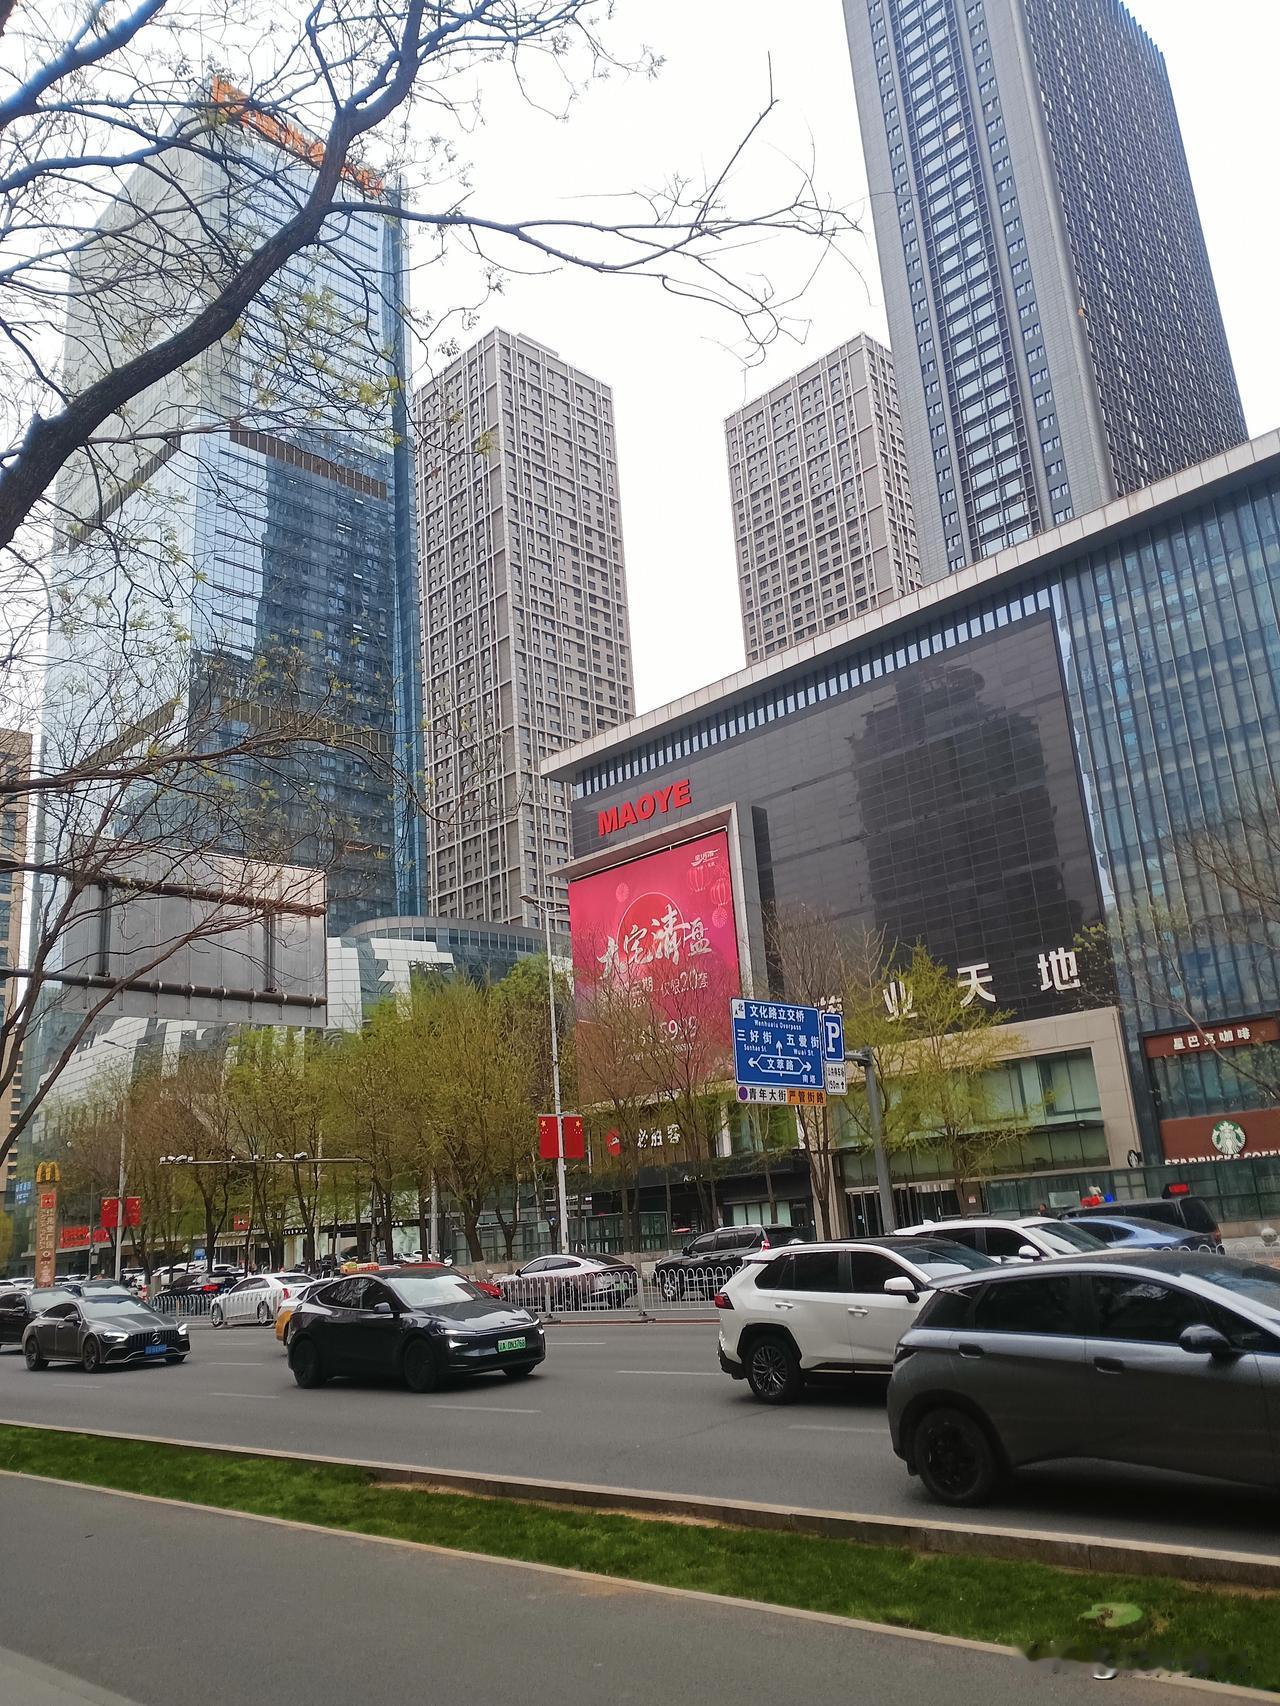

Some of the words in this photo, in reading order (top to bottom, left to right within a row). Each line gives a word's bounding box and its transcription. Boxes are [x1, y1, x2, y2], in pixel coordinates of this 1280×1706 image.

[597, 779, 692, 836] MAOYE
[749, 1005, 805, 1022] 文化路立交桥
[737, 1029, 772, 1045] 三好街
[786, 1034, 819, 1049] 五爱街
[826, 1021, 840, 1053] P
[1173, 1027, 1251, 1050] 星巴克咖啡
[767, 1058, 794, 1071] 文萃路
[802, 1074, 816, 1084] 南塔
[749, 1088, 786, 1101] 青年大街
